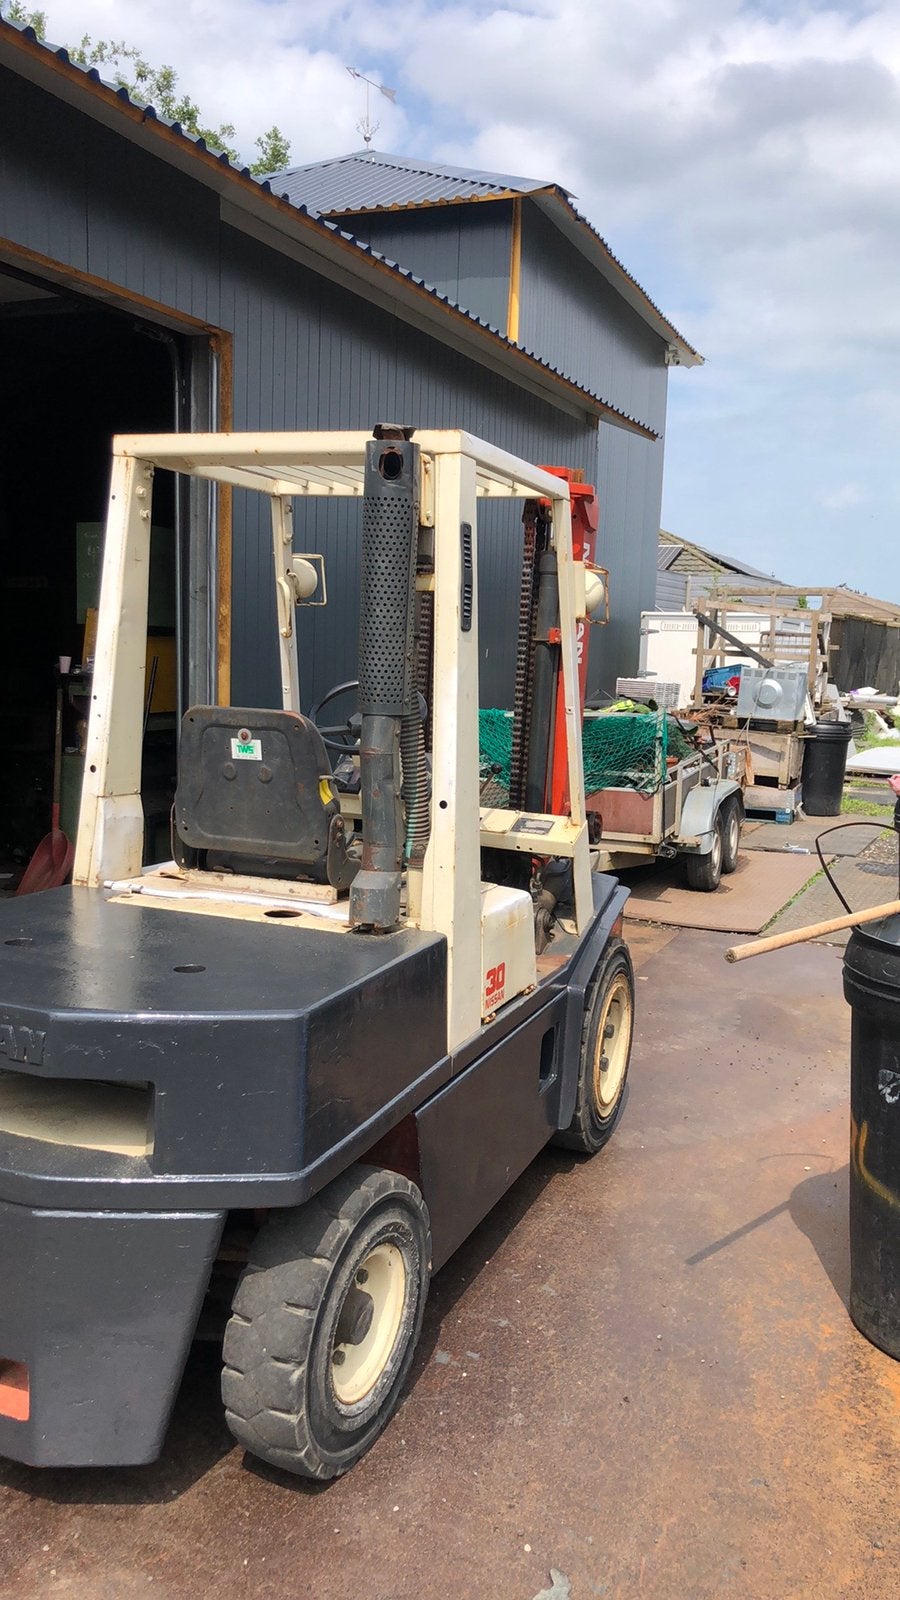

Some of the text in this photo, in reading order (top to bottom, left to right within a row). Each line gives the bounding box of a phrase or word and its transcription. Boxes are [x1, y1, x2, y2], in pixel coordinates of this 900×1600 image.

[236, 744, 255, 755] TWS
[485, 962, 505, 997] 30
[485, 989, 505, 1009] NISSAN
